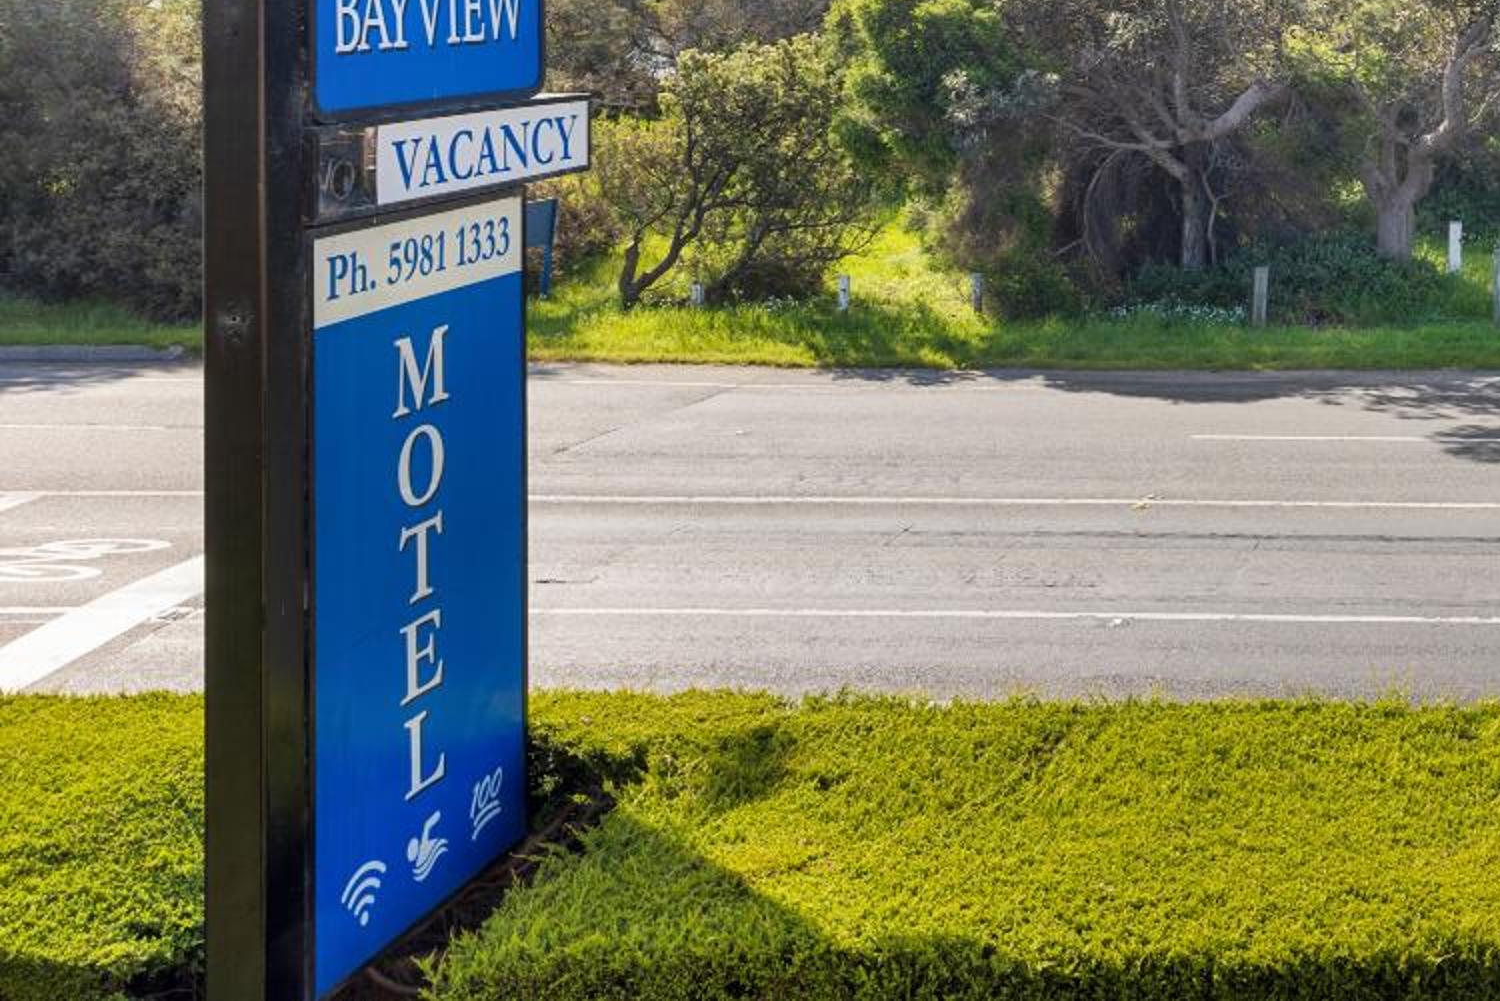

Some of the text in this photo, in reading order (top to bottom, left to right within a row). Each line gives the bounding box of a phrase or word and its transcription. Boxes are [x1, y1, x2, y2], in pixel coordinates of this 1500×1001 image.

[392, 114, 577, 192] VACANCY
[325, 216, 510, 301] Ph. 5981 1333
[392, 324, 449, 801] MOTEL
